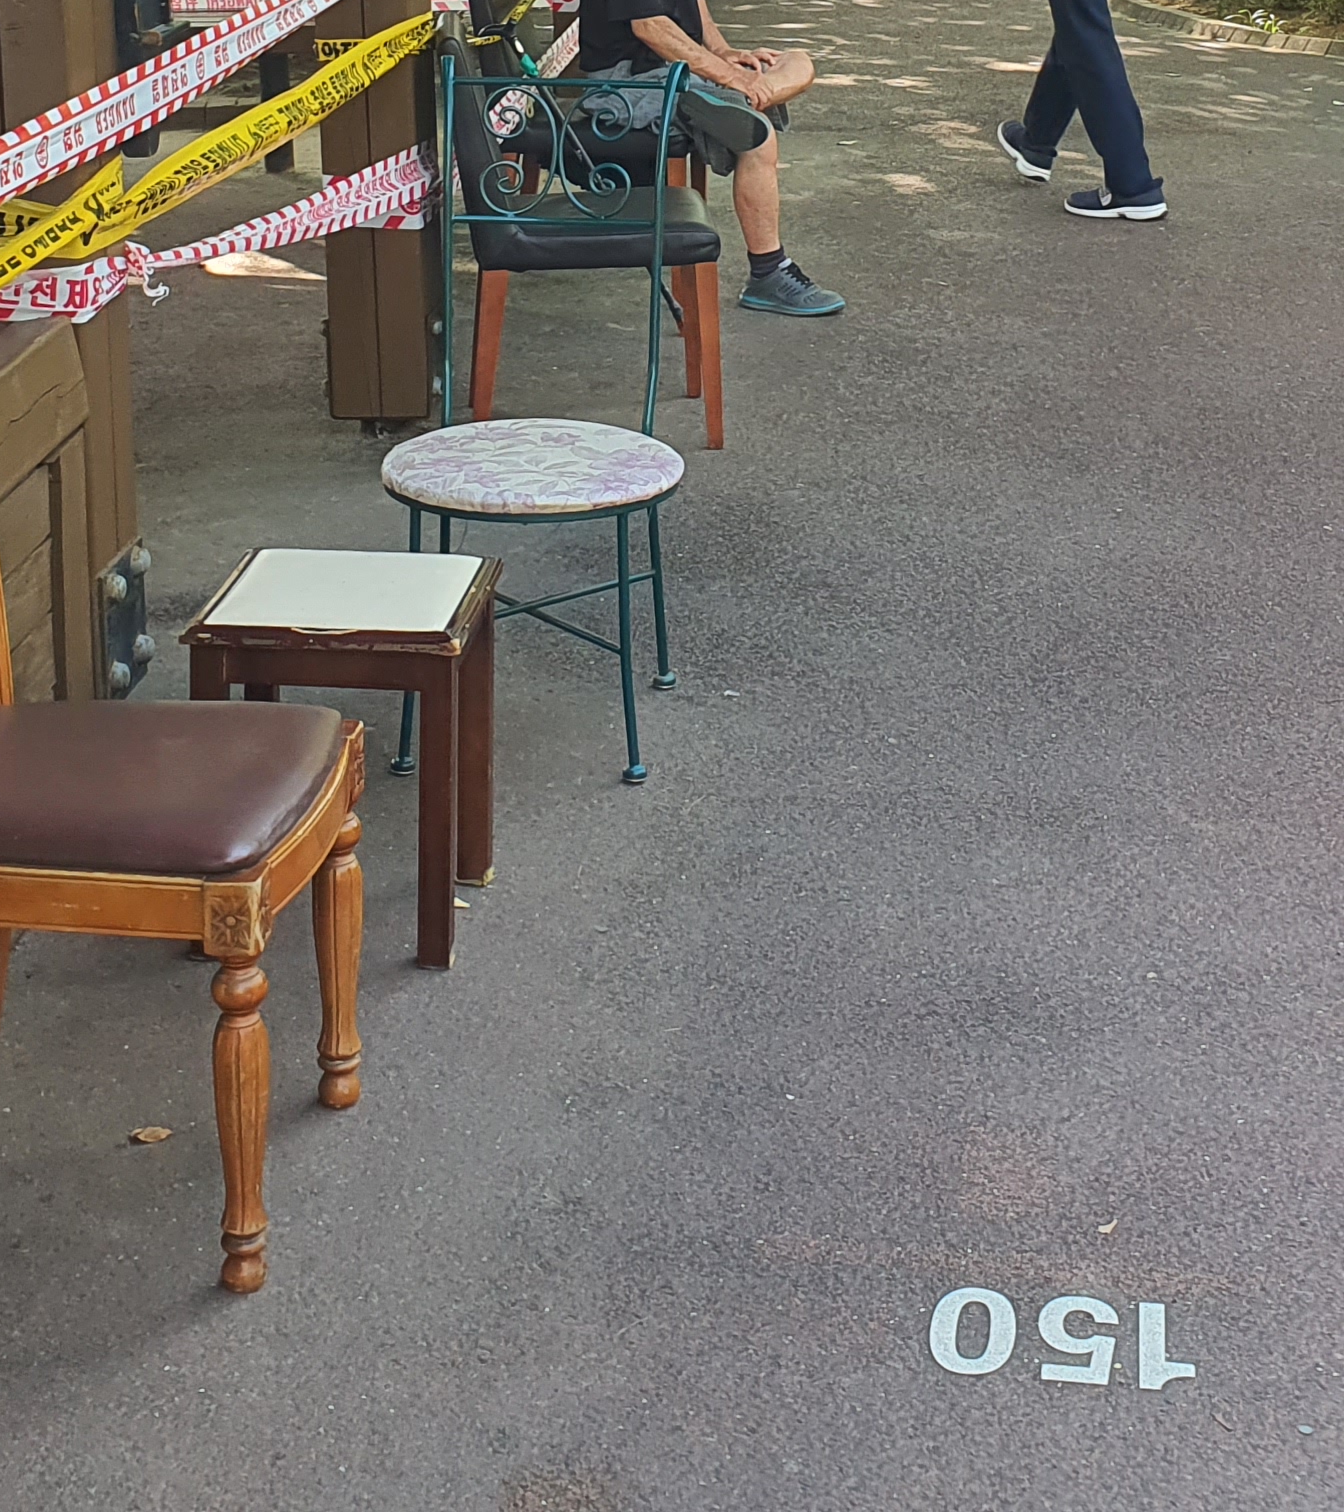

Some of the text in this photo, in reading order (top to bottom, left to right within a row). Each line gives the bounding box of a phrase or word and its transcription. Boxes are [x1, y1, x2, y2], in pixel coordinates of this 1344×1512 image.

[94, 92, 137, 135] DANGER
[63, 120, 85, 153] 위험
[929, 1286, 1196, 1391] 150
